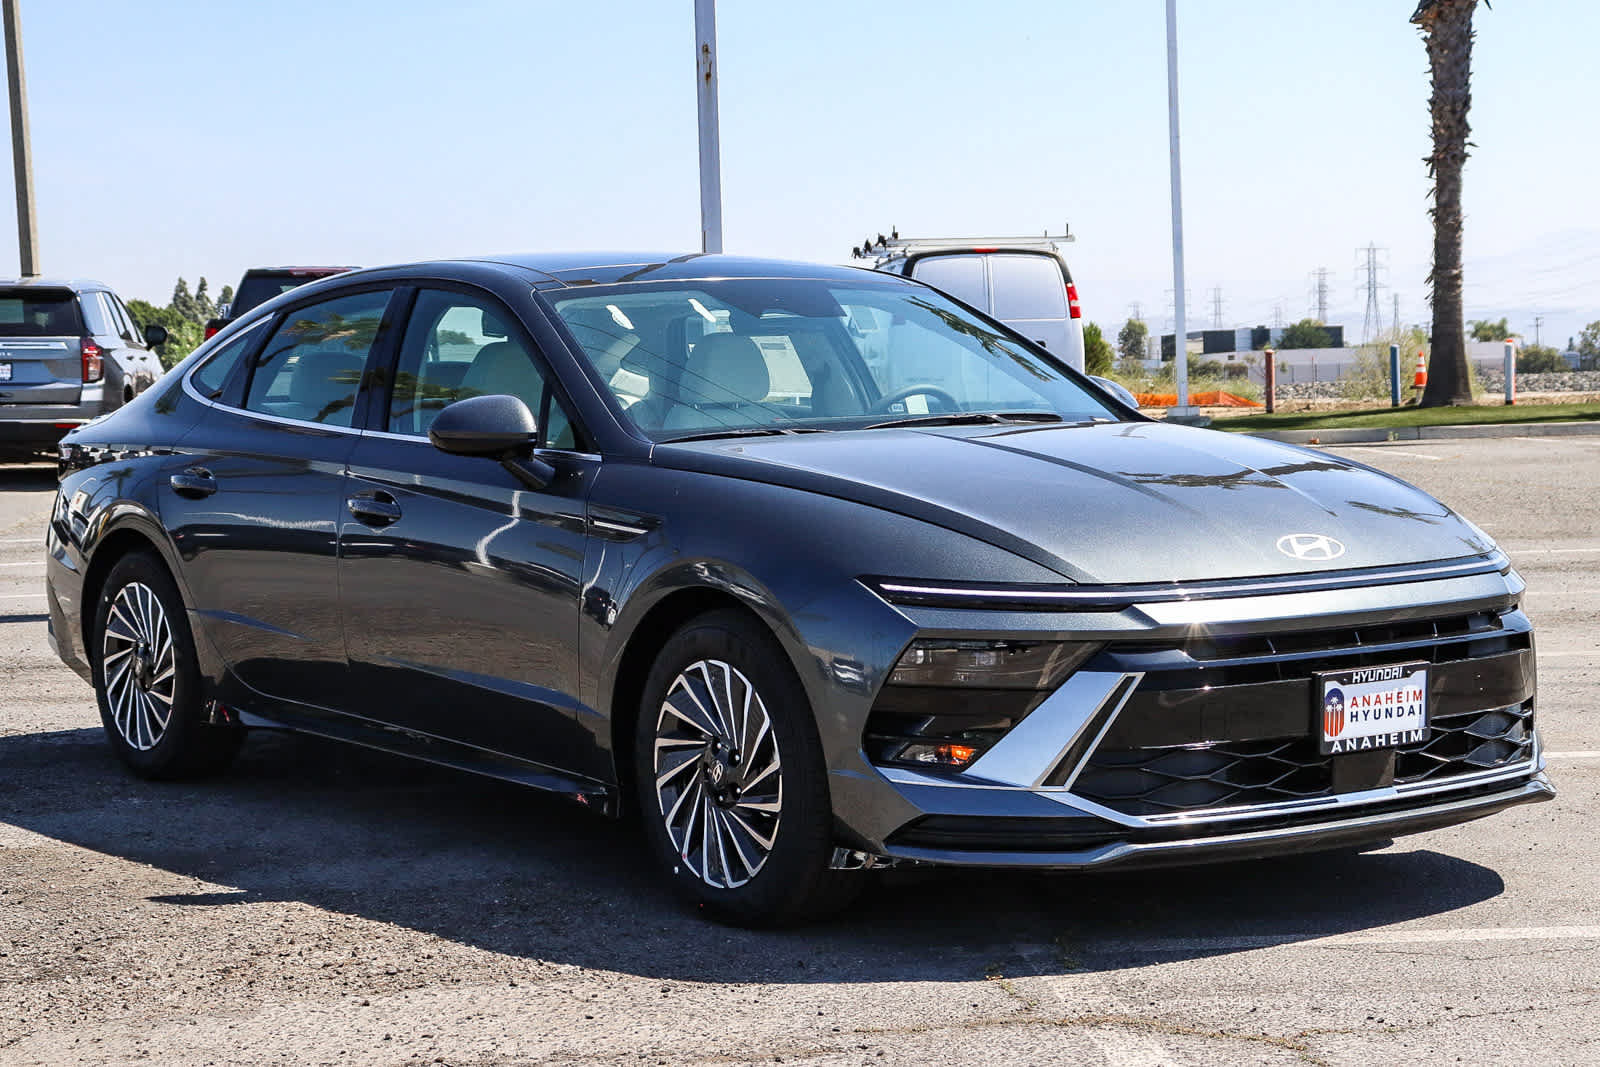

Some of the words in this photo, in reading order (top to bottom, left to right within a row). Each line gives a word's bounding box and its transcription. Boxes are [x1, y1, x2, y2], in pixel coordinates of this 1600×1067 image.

[1352, 667, 1403, 683] HYUNDAI
[1350, 689, 1423, 708] ANAHEIM
[1350, 704, 1422, 722] HYUNDAI
[1330, 730, 1423, 753] ANAHEIM
